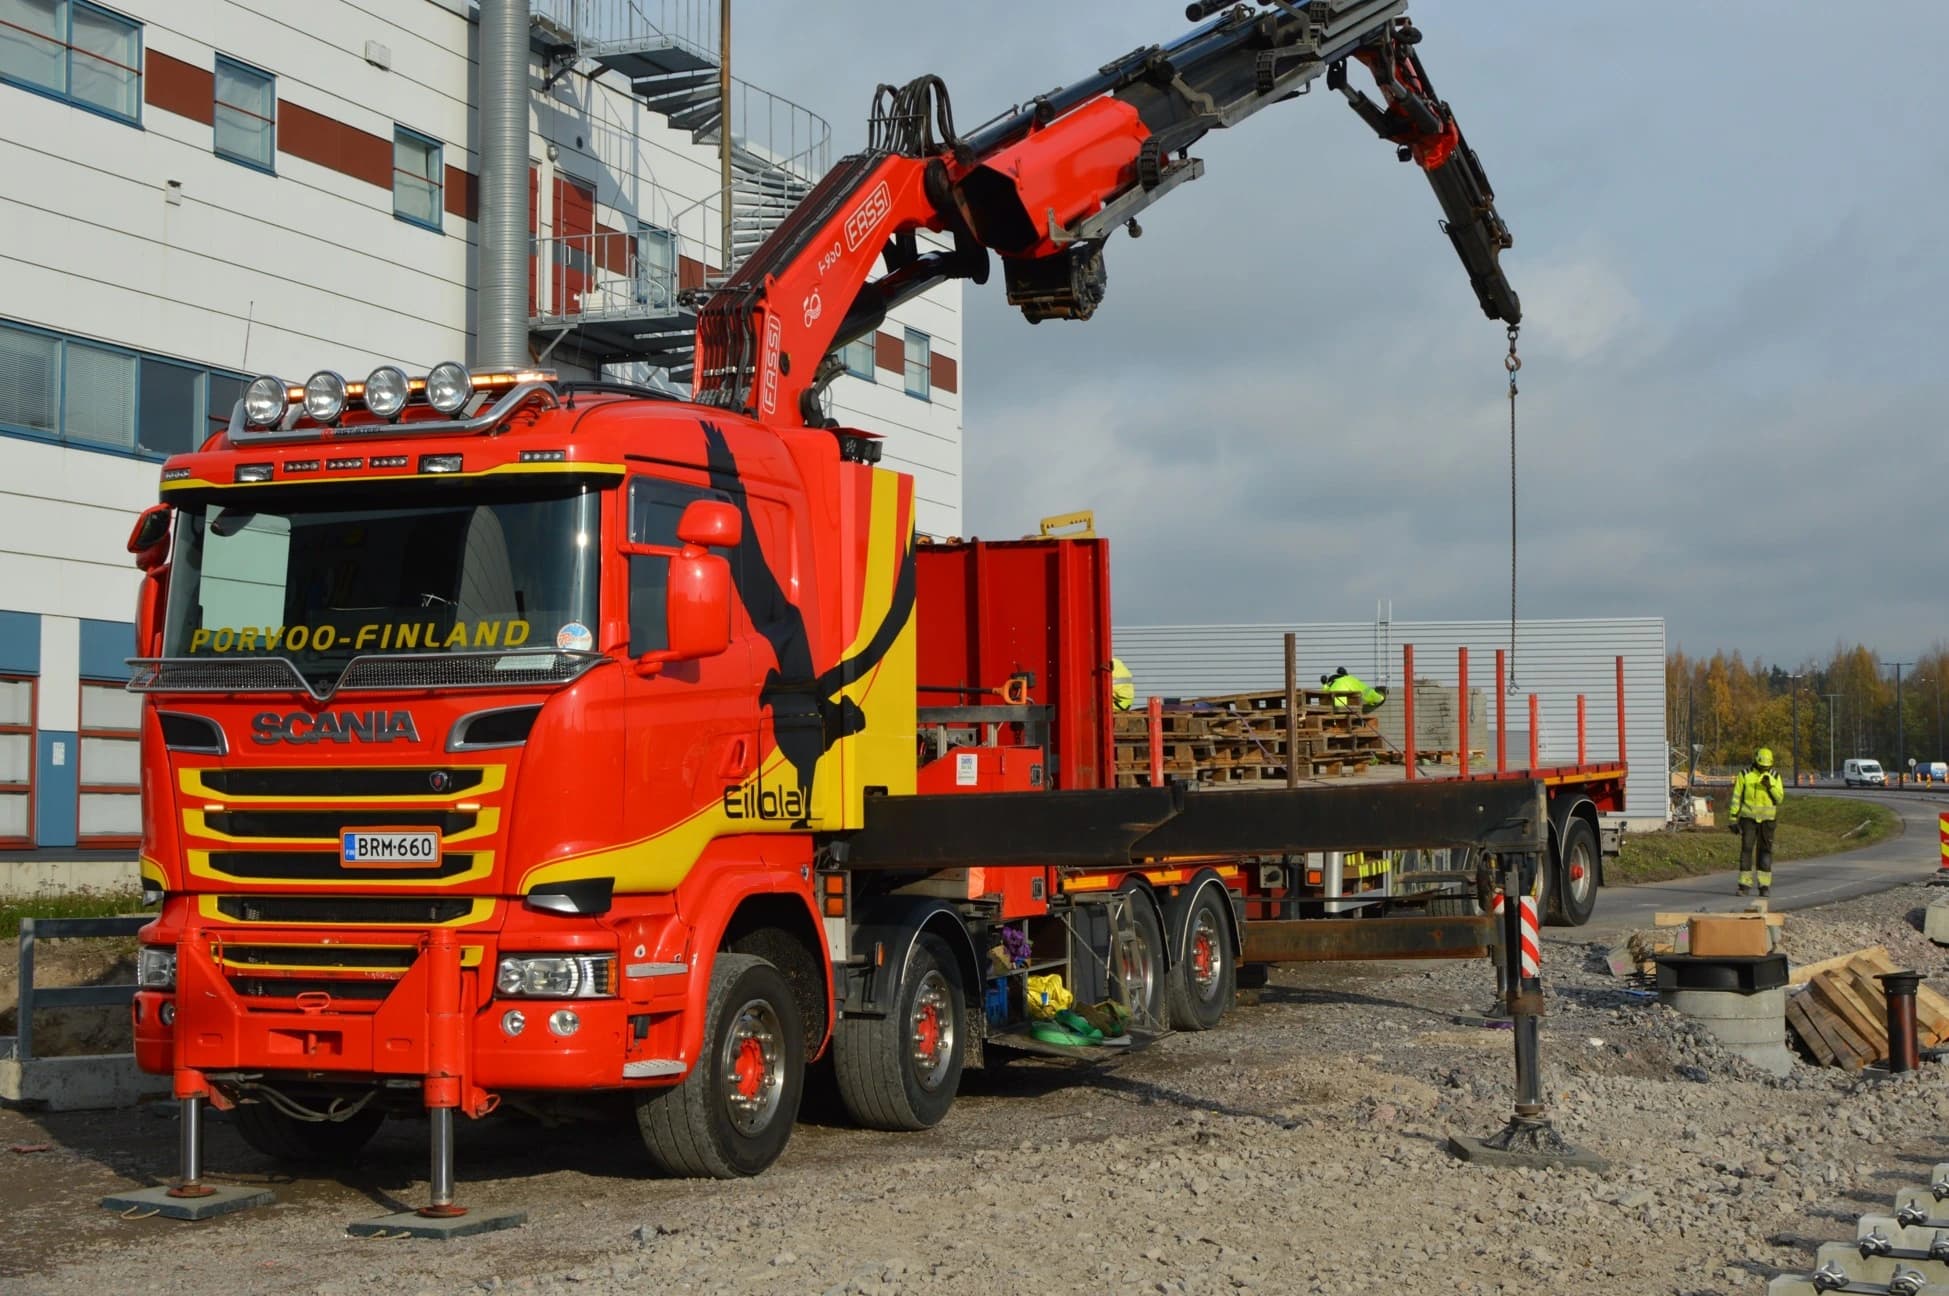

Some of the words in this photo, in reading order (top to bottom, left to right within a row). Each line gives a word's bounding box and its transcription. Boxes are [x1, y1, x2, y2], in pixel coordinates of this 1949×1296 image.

[847, 186, 889, 246] FASSI
[764, 321, 780, 408] FASSI
[190, 619, 530, 653] PORVOO-FINLAND
[251, 710, 421, 745] SCANIA
[723, 782, 803, 819] Eilola
[358, 837, 432, 857] BRM-660
